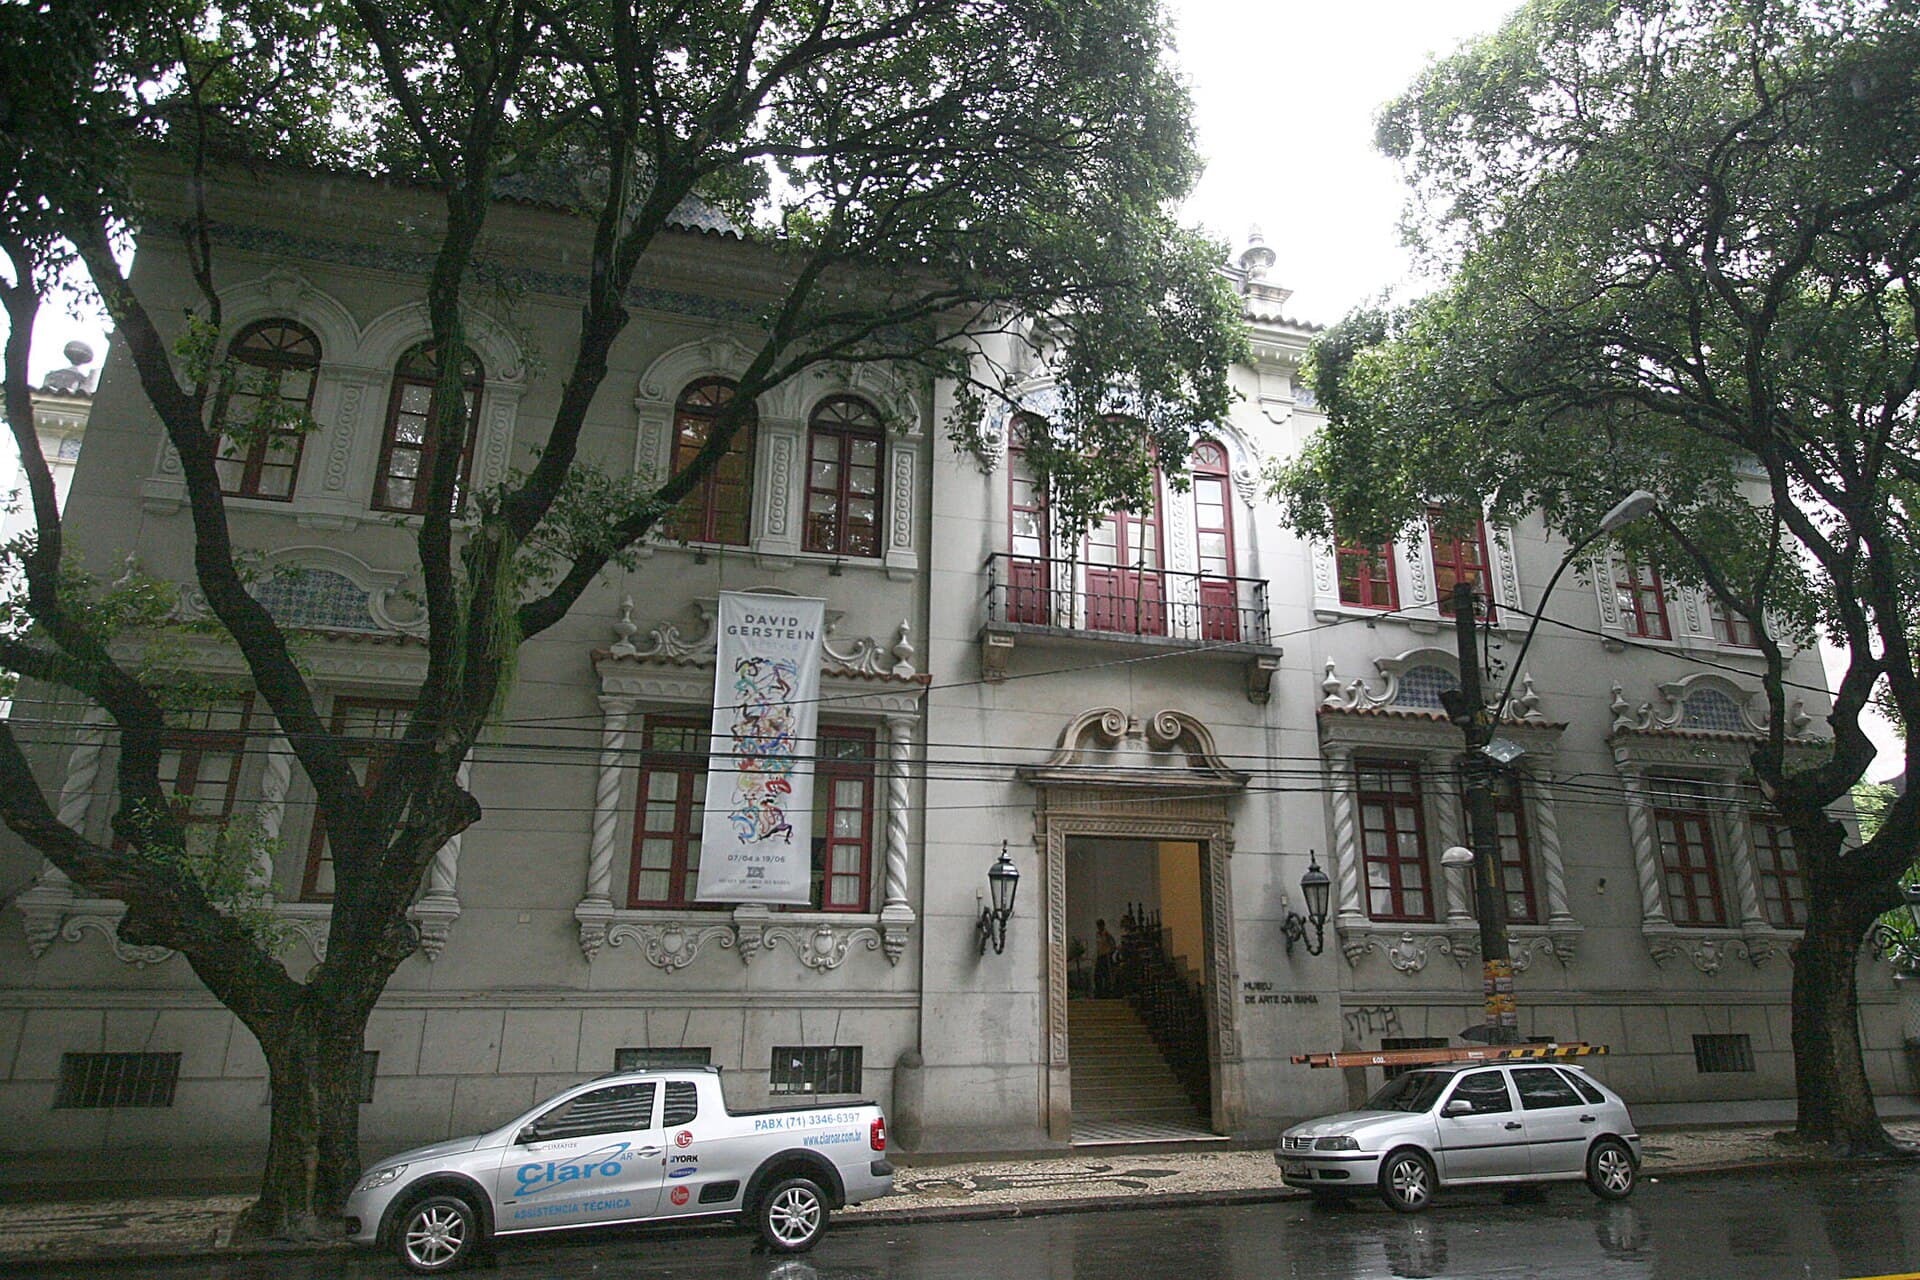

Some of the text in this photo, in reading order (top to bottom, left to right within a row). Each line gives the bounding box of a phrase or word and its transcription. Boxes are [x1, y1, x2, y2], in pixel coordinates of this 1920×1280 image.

[745, 614, 798, 627] DAVID
[727, 625, 815, 640] GERSTEIN
[727, 854, 753, 863] 07/04
[1258, 995, 1280, 1004] ARTE
[1281, 995, 1293, 1004] DA
[755, 1112, 860, 1131] PABX (71) 3346-6397
[802, 1129, 862, 1146] www.claroar.com.br
[675, 1154, 698, 1163] YORK
[516, 1152, 633, 1184] Claro AR
